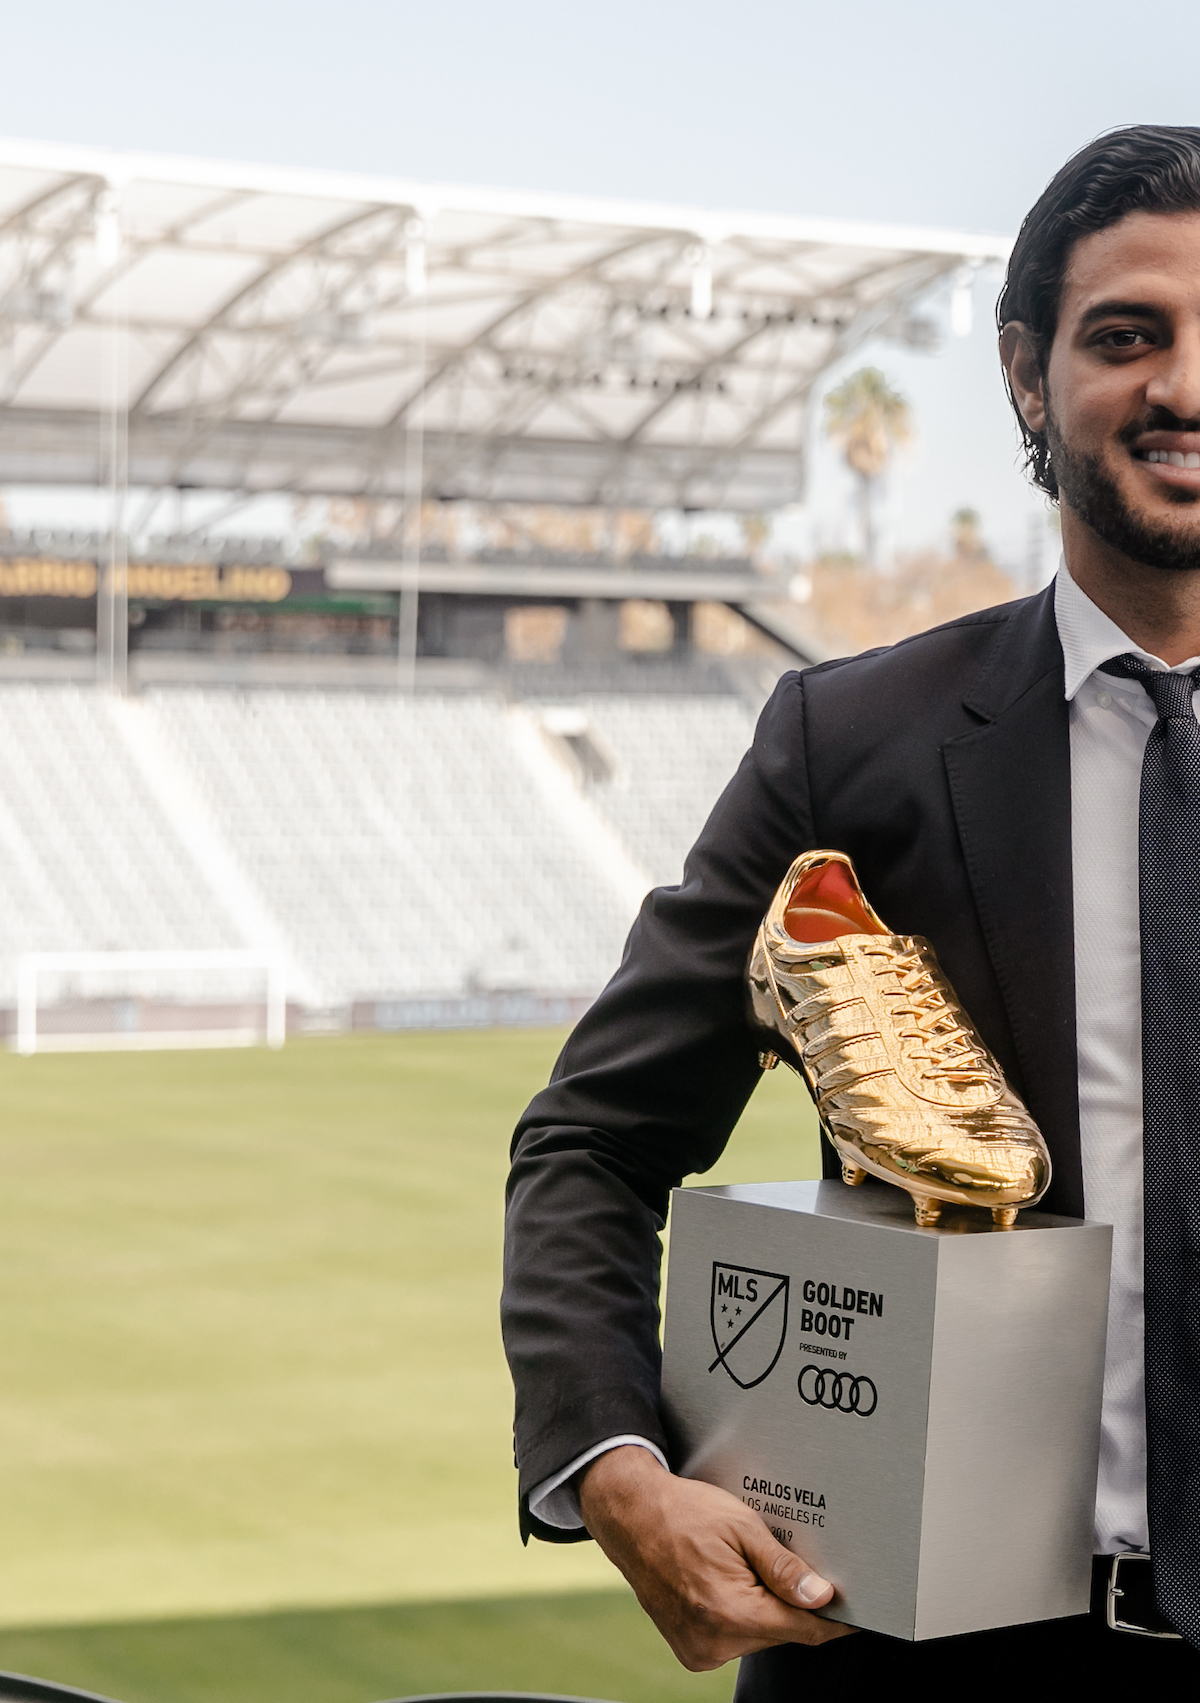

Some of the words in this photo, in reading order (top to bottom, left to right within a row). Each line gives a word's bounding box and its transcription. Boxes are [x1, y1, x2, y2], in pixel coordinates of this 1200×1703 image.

[718, 1272, 758, 1303] MLS
[803, 1279, 884, 1318] GOLDEN
[801, 1308, 855, 1341] BOOT
[799, 1342, 838, 1359] PRESENTED
[838, 1350, 848, 1361] BY
[742, 1475, 792, 1501] CARLOS
[794, 1487, 827, 1511] VELA
[763, 1501, 810, 1524] ANGELES
[812, 1513, 825, 1528] FC
